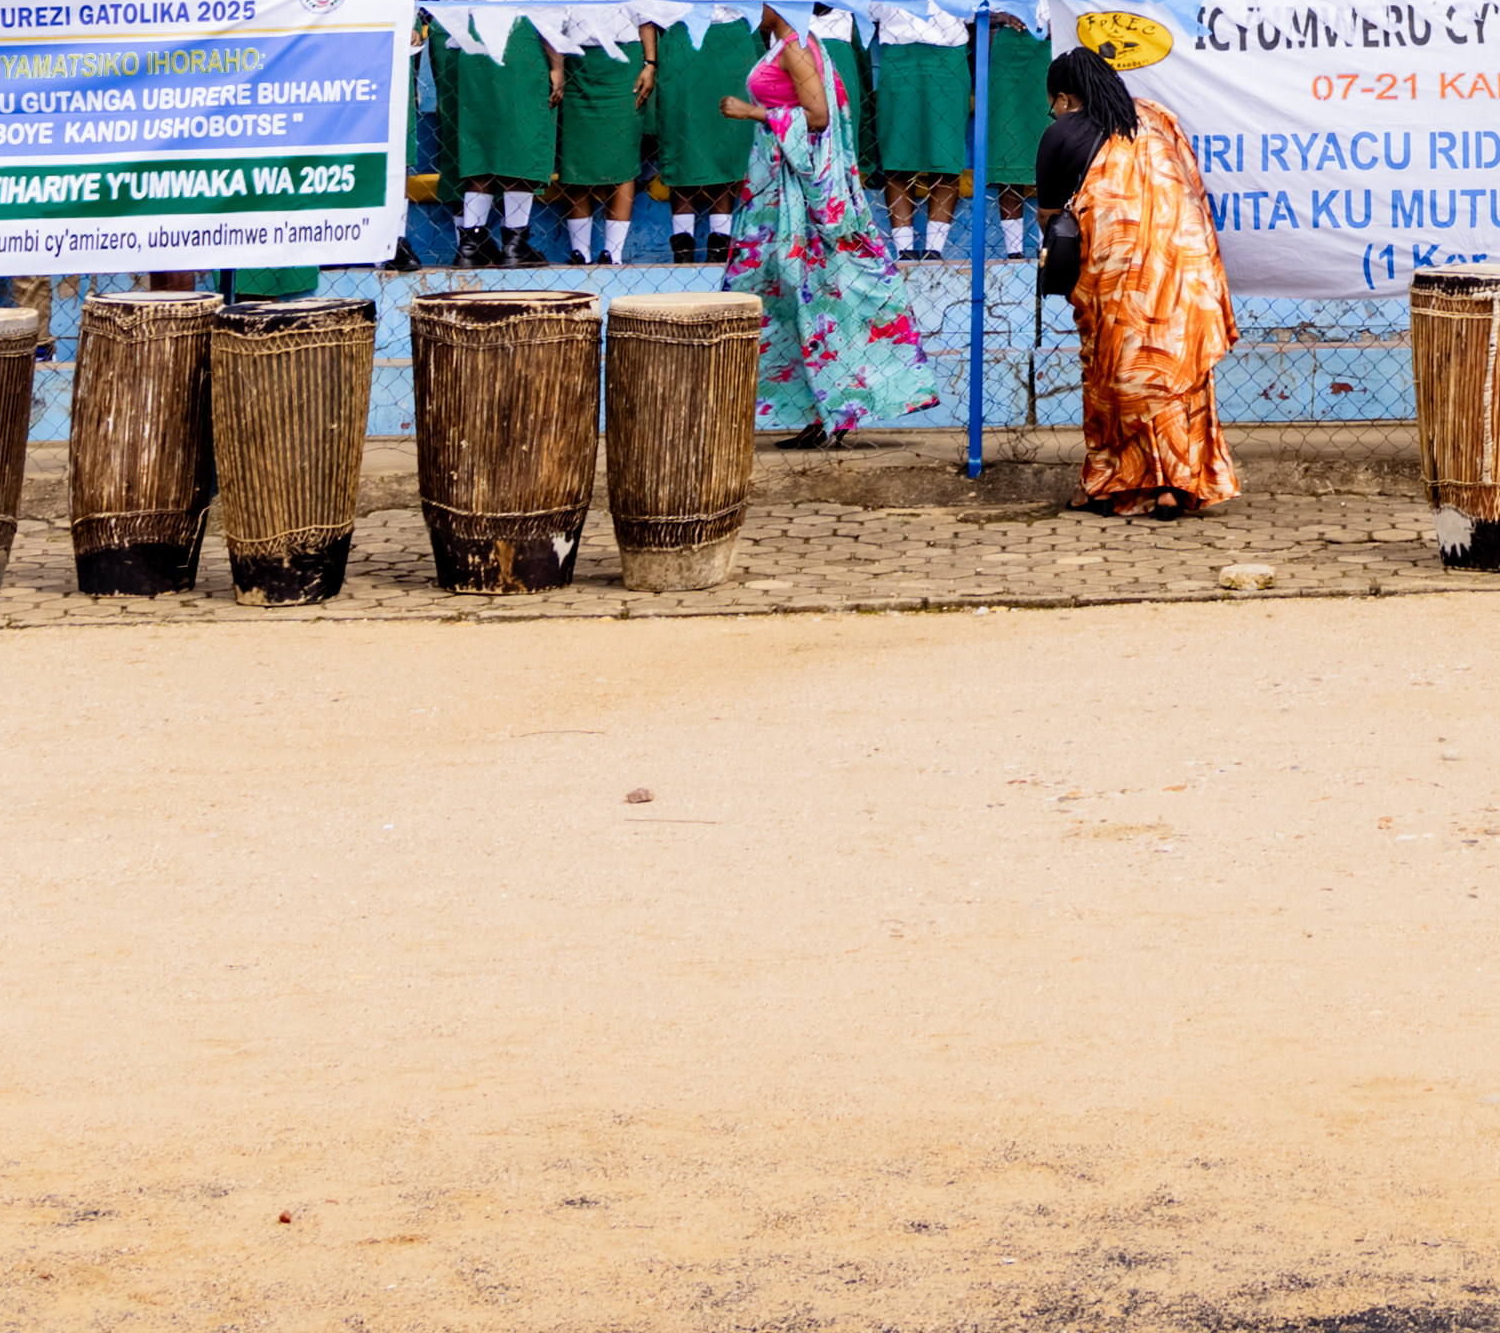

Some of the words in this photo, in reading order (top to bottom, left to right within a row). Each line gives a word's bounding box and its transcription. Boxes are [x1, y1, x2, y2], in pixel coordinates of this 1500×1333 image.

[79, 2, 190, 26] GATOLIKA
[197, 0, 256, 22] 2025
[147, 46, 266, 74] IHORAHO:
[21, 89, 137, 114] GUTANGA
[143, 83, 252, 110] UBURERE
[258, 79, 378, 104] BUHAMYE:
[1312, 73, 1418, 101] 07-21
[64, 120, 138, 144] KANDI
[143, 113, 287, 140] USHOBOTSE
[1262, 132, 1411, 172] RYACU
[106, 169, 248, 201] Y'UMWAKA
[252, 167, 296, 196] WA
[299, 165, 356, 194] 2025
[1311, 189, 1372, 230] KU
[44, 227, 142, 258] cy'amizero,
[147, 223, 268, 250] ubuvandimwe
[274, 218, 370, 245] n'amahoro"
